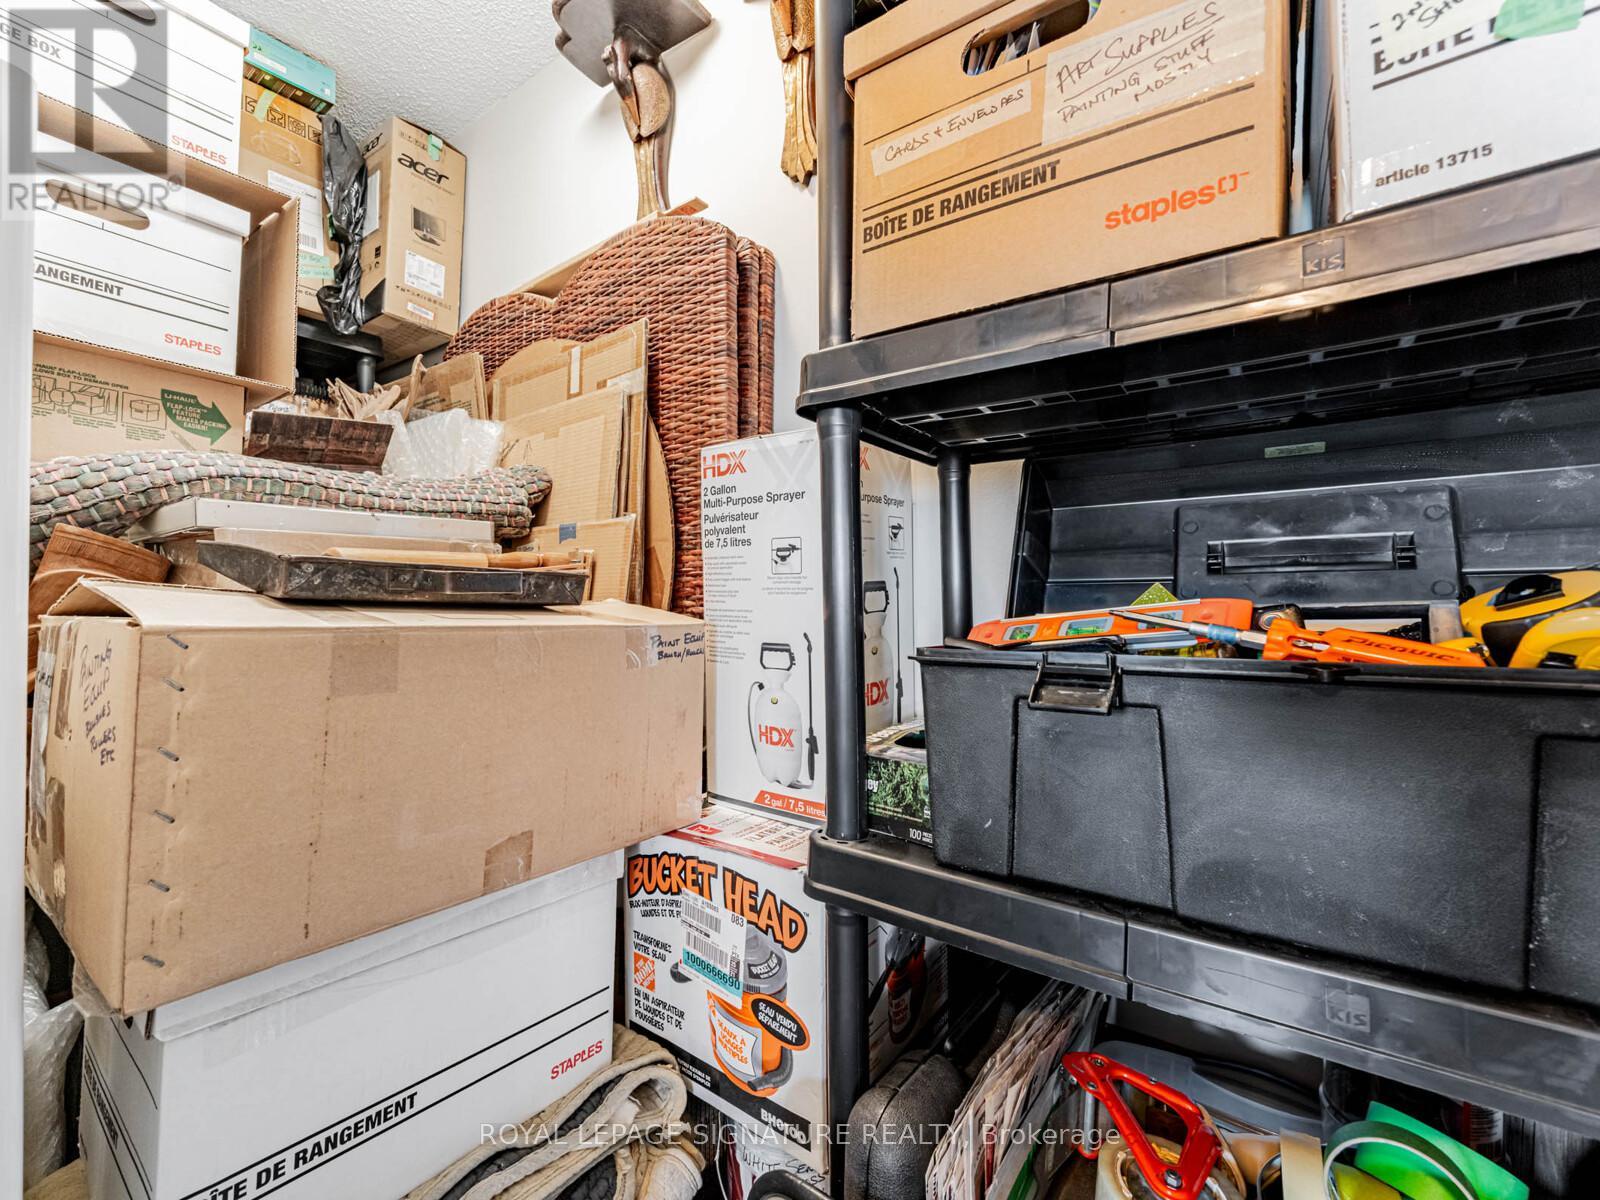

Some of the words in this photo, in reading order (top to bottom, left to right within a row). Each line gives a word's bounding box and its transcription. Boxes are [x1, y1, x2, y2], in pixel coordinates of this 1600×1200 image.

[28, 34, 61, 59] BOX
[1057, 49, 1101, 94] ART
[1057, 72, 1141, 123] PAINTING
[1154, 29, 1216, 72] STUFF
[171, 134, 227, 165] STAPLES
[884, 132, 930, 162] CARDS
[397, 153, 449, 184] acer
[1375, 163, 1430, 187] article
[1436, 143, 1493, 170] 13715
[863, 214, 907, 244] BOÎTE
[912, 203, 935, 227] DE
[939, 159, 1061, 218] RANGEMENT
[1105, 184, 1216, 230] staples
[1306, 254, 1341, 273] KIS
[34, 264, 124, 297] ANGEMENT
[164, 332, 222, 356] STAPLES
[111, 382, 129, 390] OPEN
[172, 408, 201, 418] FEATURE
[176, 415, 199, 425] MAKES
[200, 419, 227, 430] PACKING
[703, 449, 747, 479] HDX
[703, 487, 709, 497] 2
[710, 485, 737, 496] Gallon
[703, 495, 763, 509] Multi-Purpose
[766, 490, 806, 504] Sprayer
[883, 494, 905, 509] Sprayer
[703, 511, 759, 524] Pulvérisateur
[704, 525, 746, 538] polyvalent
[704, 539, 714, 549] de
[716, 538, 728, 549] 7,5
[730, 537, 752, 548] litres
[650, 634, 681, 648] PAINT
[758, 723, 795, 748] HDX
[100, 746, 116, 766] ETC
[764, 794, 770, 804] 2
[772, 796, 783, 807] gal
[789, 799, 805, 813] 7,5
[806, 806, 826, 817] litres
[909, 828, 922, 840] 100
[628, 851, 718, 899] BUCKET
[722, 866, 808, 953] HEAD
[730, 913, 744, 928] 083
[633, 941, 651, 956] VOTRE
[651, 949, 667, 962] SEAU
[686, 951, 741, 991] 1000666690
[634, 987, 641, 997] EN
[642, 991, 650, 1002] UN
[651, 996, 685, 1020] ASPIRATEUR
[634, 998, 642, 1008] DE
[666, 1014, 674, 1025] ET
[675, 1020, 683, 1031] DE
[759, 1001, 775, 1017] SEAU
[776, 1012, 797, 1032] VENDU
[550, 1040, 603, 1080] STAPLES
[255, 1159, 286, 1190] DE
[293, 1091, 418, 1170] RANGEMENT
